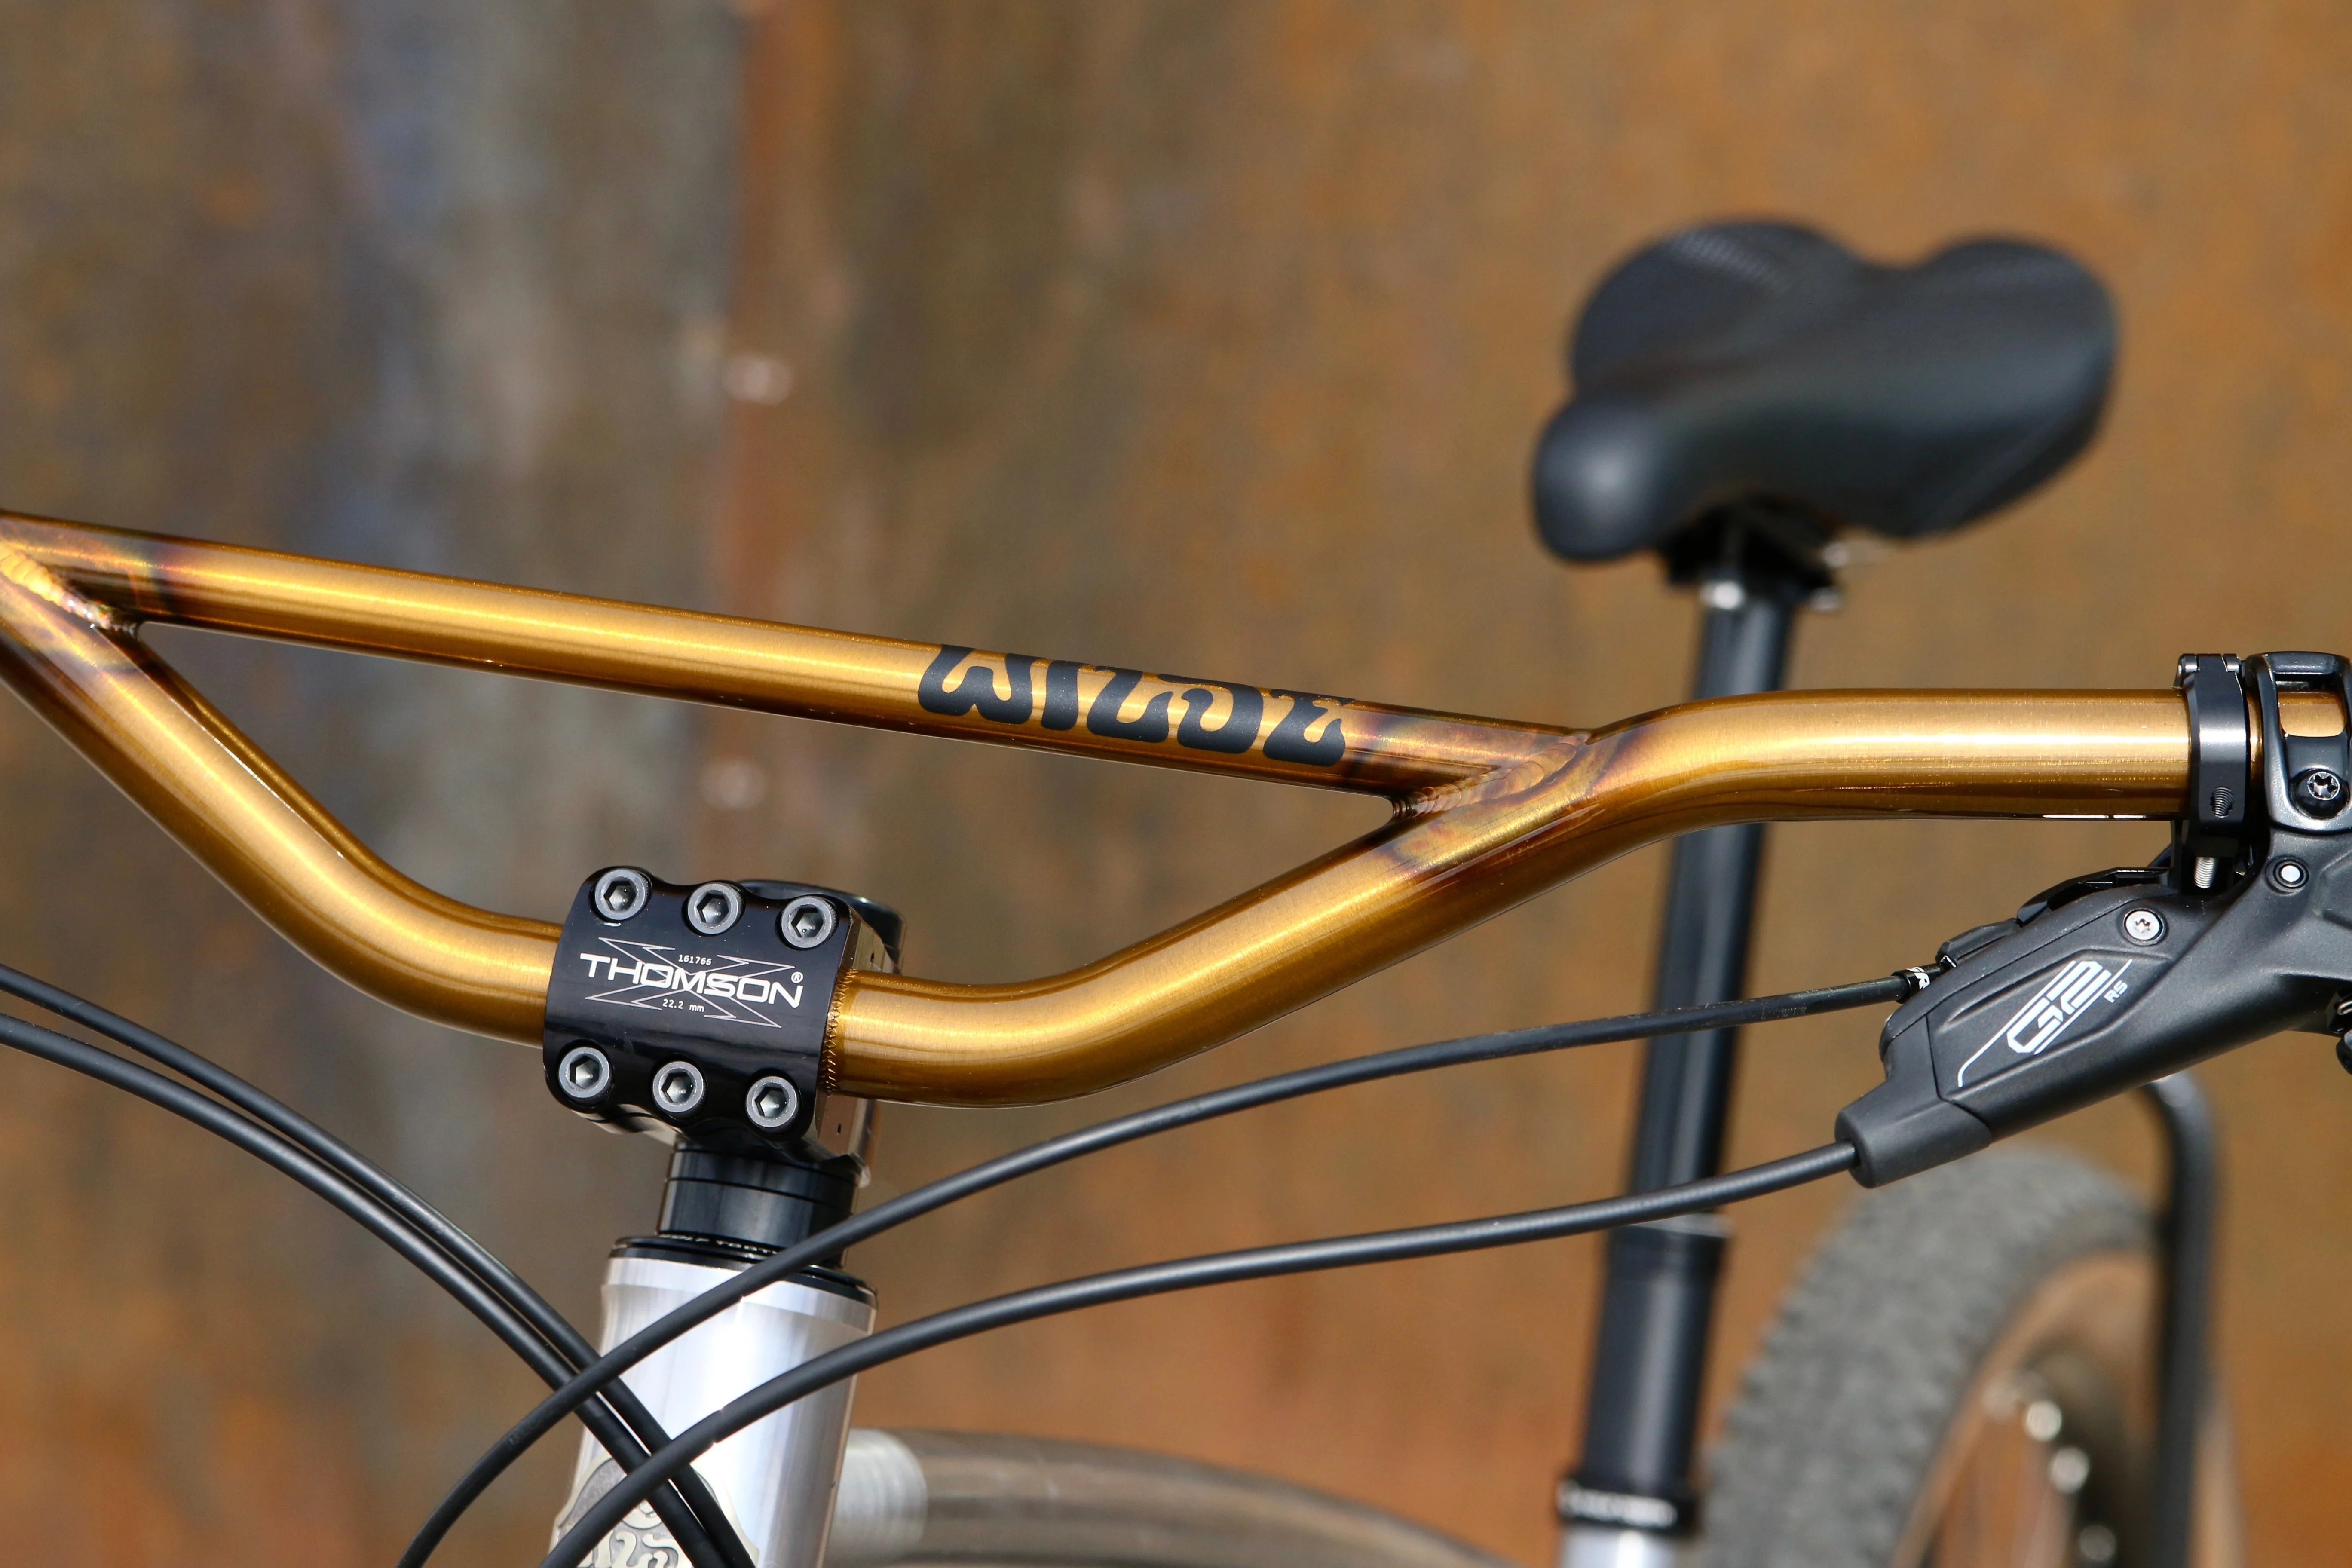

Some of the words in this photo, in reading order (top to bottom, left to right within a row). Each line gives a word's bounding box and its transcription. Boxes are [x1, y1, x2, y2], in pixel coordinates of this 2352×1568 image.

[678, 954, 712, 966] 161766
[2104, 980, 2128, 1003] RS
[662, 998, 684, 1010] 22.2
[689, 1004, 705, 1013] mm
